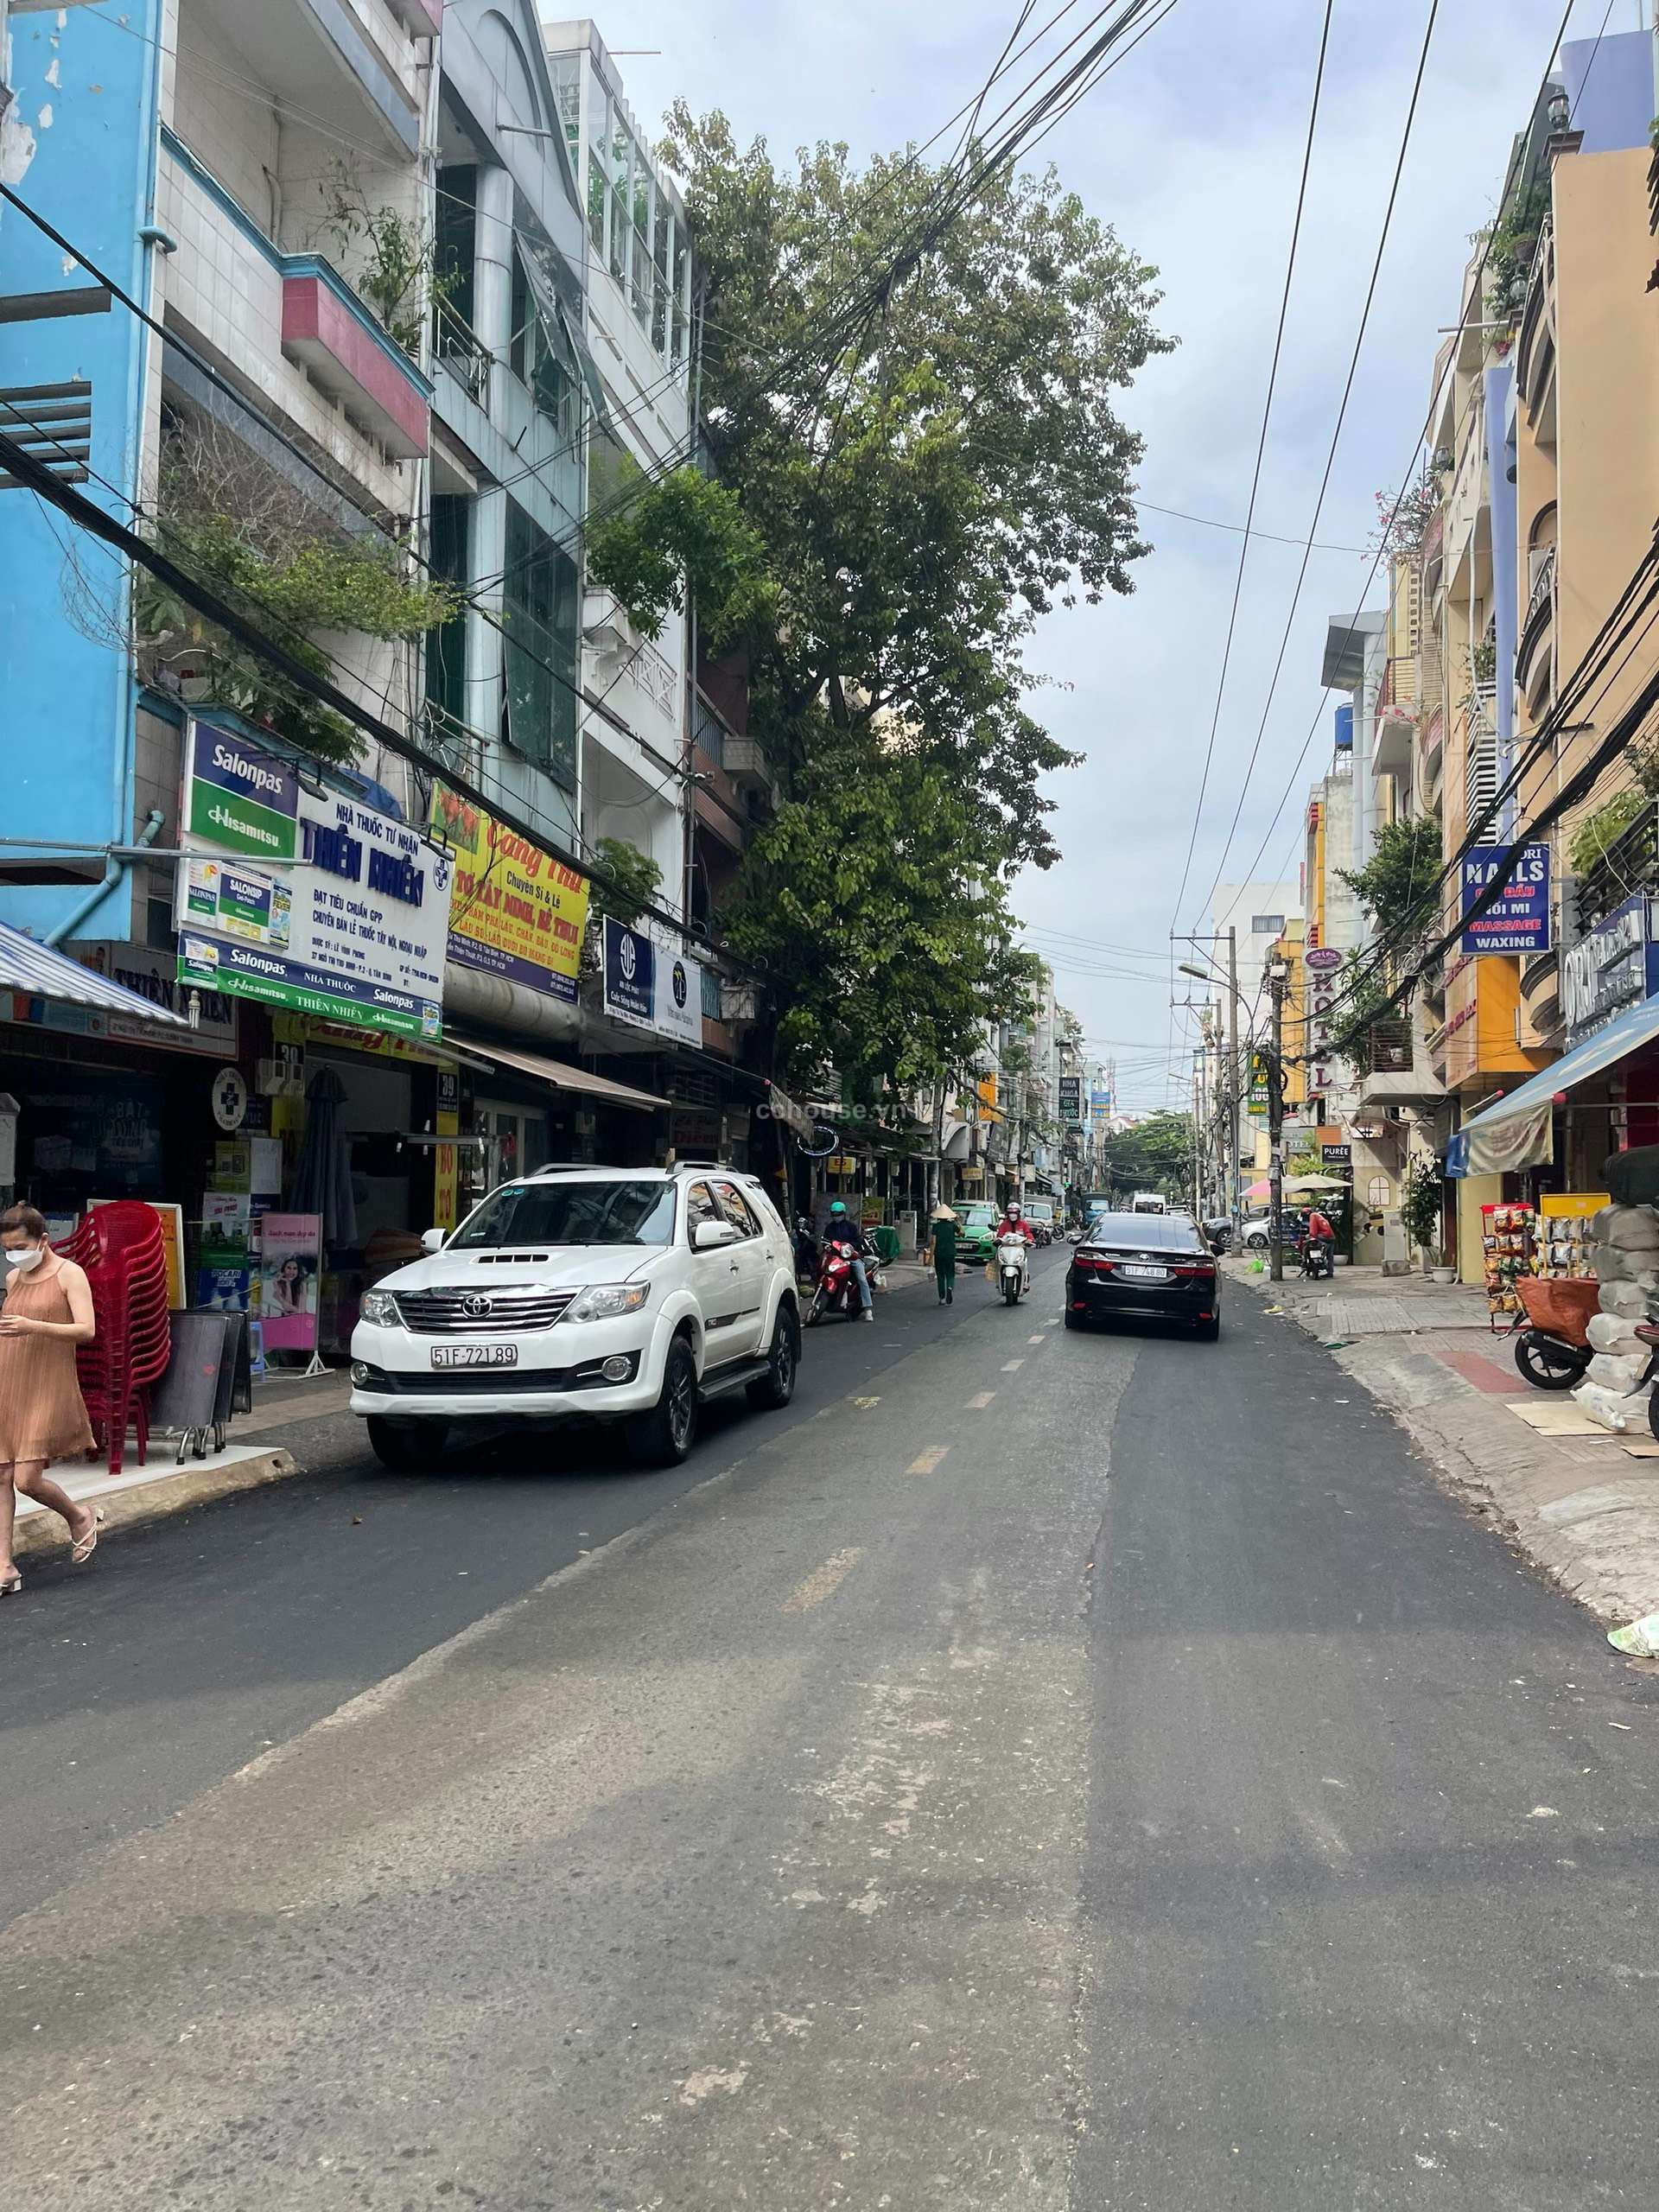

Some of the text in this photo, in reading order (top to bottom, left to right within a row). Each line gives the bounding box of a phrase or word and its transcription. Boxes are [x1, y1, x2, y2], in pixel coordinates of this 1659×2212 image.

[213, 744, 283, 794] Salonpas
[207, 804, 279, 848] Hisamitsu
[336, 803, 419, 856] NHÀ THUỐC TƯ NHÂN
[300, 817, 363, 882] THIÊN
[1466, 861, 1545, 884] NALS
[506, 871, 534, 897] Chuyên
[544, 891, 551, 904] &
[314, 889, 383, 924] ĐẠT TIÊU CHUẨN GPP
[1510, 903, 1530, 914] MI
[313, 909, 334, 929] CHUYÊN
[359, 924, 376, 941] THUỐC
[1469, 918, 1542, 932] MASSAGE
[1476, 936, 1535, 949] WAXING
[230, 949, 286, 976] Salonpas
[227, 978, 286, 1000] Hisamitsu
[304, 972, 357, 993] NHÀ THUỐC
[296, 995, 364, 1020] THIÊN NHIÊN
[372, 988, 414, 1010] Salonpas
[442, 1075, 454, 1096] 39
